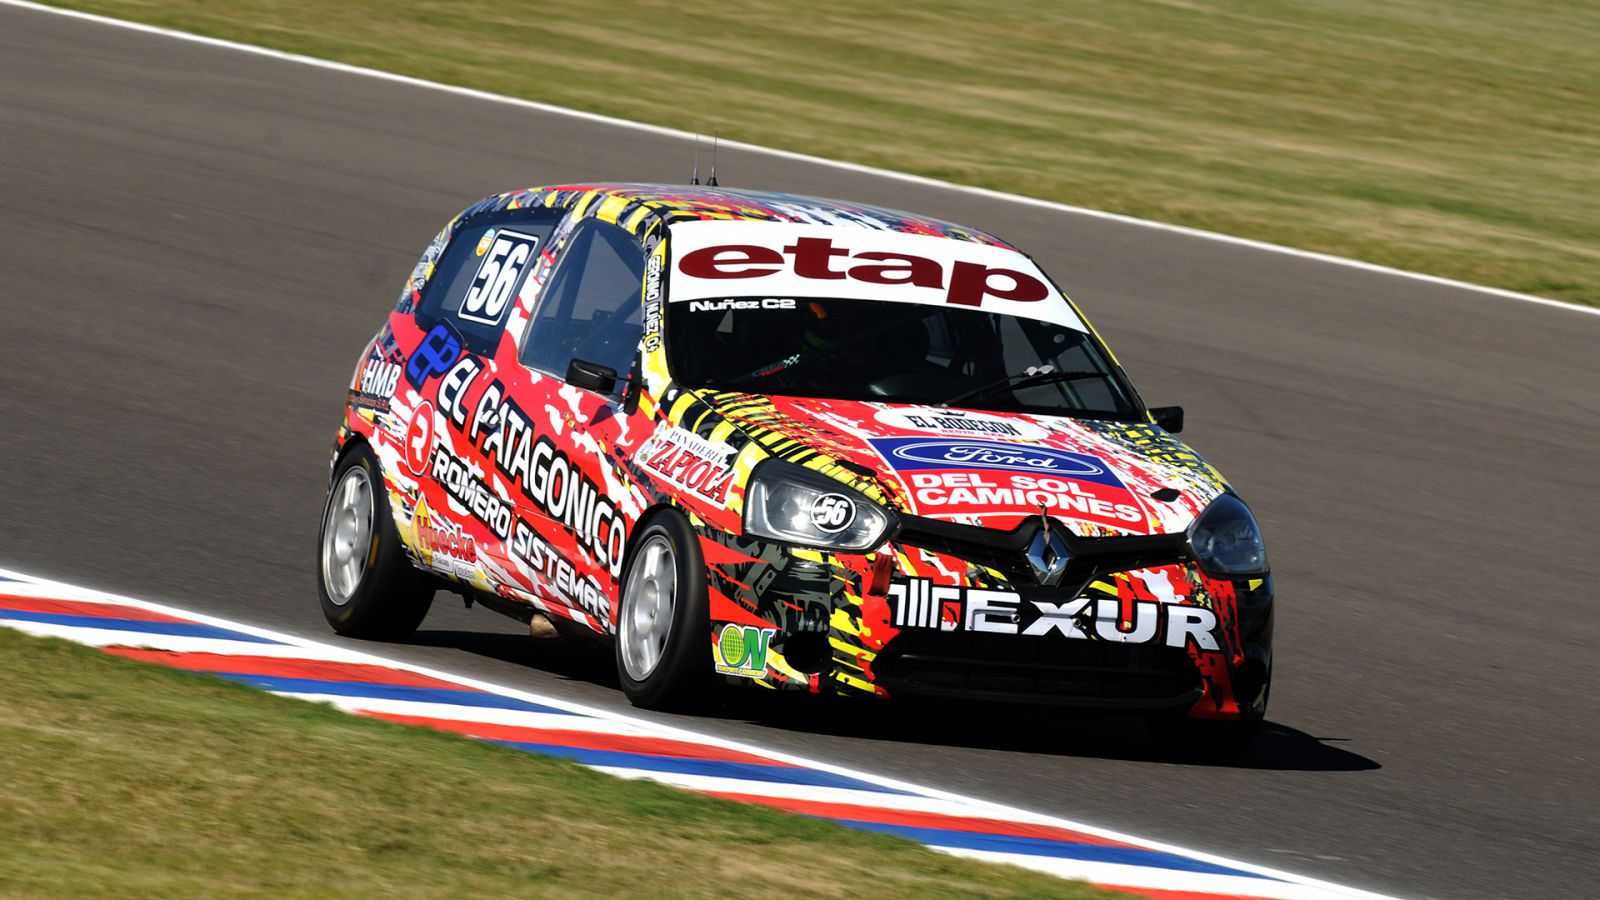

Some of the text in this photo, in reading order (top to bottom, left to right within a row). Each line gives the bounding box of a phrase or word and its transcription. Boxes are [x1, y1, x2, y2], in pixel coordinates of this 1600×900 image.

[467, 238, 529, 317] 56
[678, 236, 1050, 308] etap
[690, 299, 796, 312] Nuñez C2
[362, 359, 402, 398] HMB
[903, 415, 1022, 436] EL BODEGON
[438, 358, 625, 577] EL PATAGONICO
[647, 440, 735, 504] ZAPIOLA
[944, 443, 1059, 469] Ford
[910, 473, 1097, 498] DEL SOL
[916, 487, 1142, 522] CAMIONES
[820, 502, 847, 526] 56
[417, 515, 477, 563] Huecke
[432, 450, 610, 627] ROMERO SISTEMAS
[720, 626, 773, 671] ON
